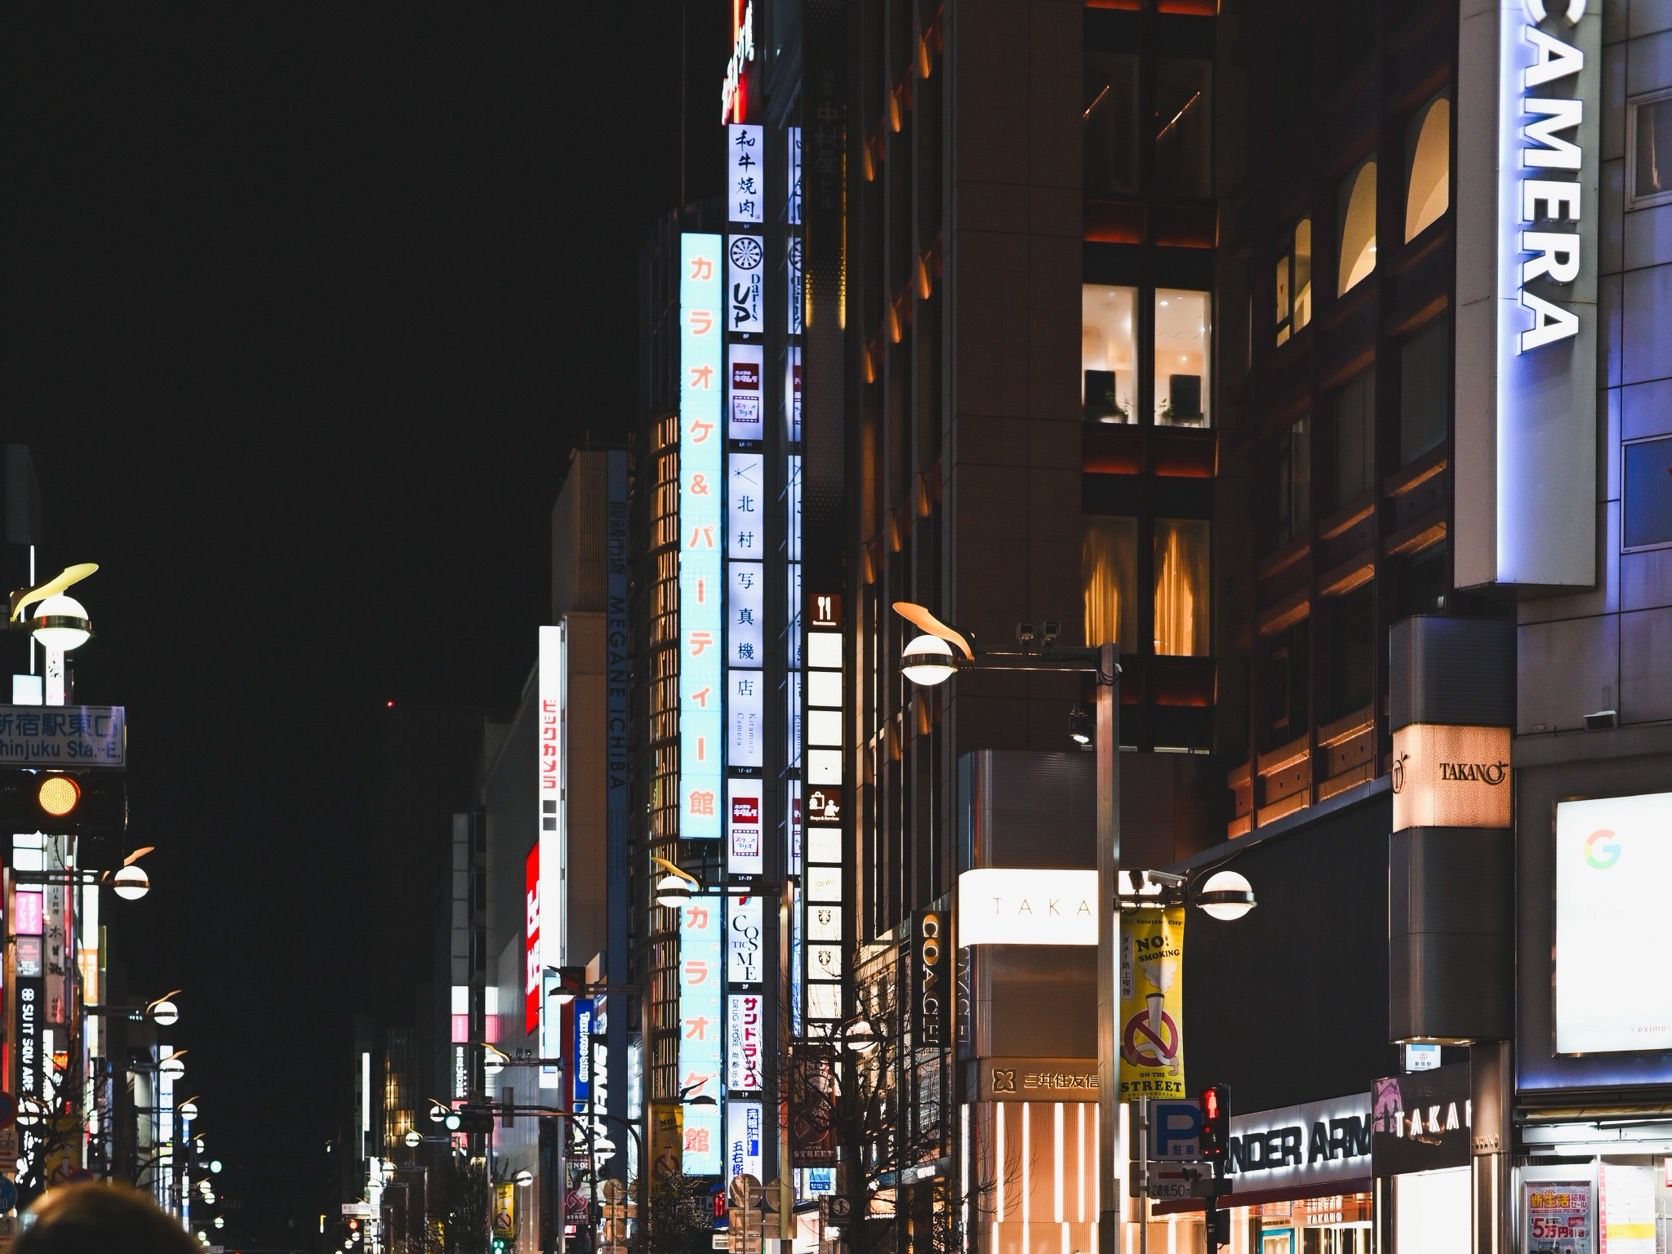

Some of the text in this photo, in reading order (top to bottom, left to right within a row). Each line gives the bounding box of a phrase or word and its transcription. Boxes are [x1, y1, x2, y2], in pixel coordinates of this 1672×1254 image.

[735, 129, 757, 220] 和牛焼肉
[733, 283, 751, 328] UP
[751, 273, 760, 322] Darts
[688, 257, 715, 816] カラオケ&パーティー館
[737, 495, 755, 697] 北村写真機店
[609, 597, 626, 790] MEGANE ICHIBA
[736, 712, 744, 746] Camera
[748, 713, 756, 754] Kitamura
[1440, 760, 1510, 786] TAKANO
[1584, 829, 1622, 870] G
[993, 897, 1091, 916] TAKA
[1135, 935, 1169, 952] NO!
[1138, 949, 1181, 963] SMOKING
[922, 914, 939, 1044] COACH
[22, 1004, 34, 1035] SUIT
[684, 905, 709, 1153] カラオケ館
[1023, 1073, 1098, 1089] 三井住友信
[1120, 1081, 1181, 1093] STREET
[1157, 1104, 1202, 1155] P
[793, 1150, 834, 1158] STREET
